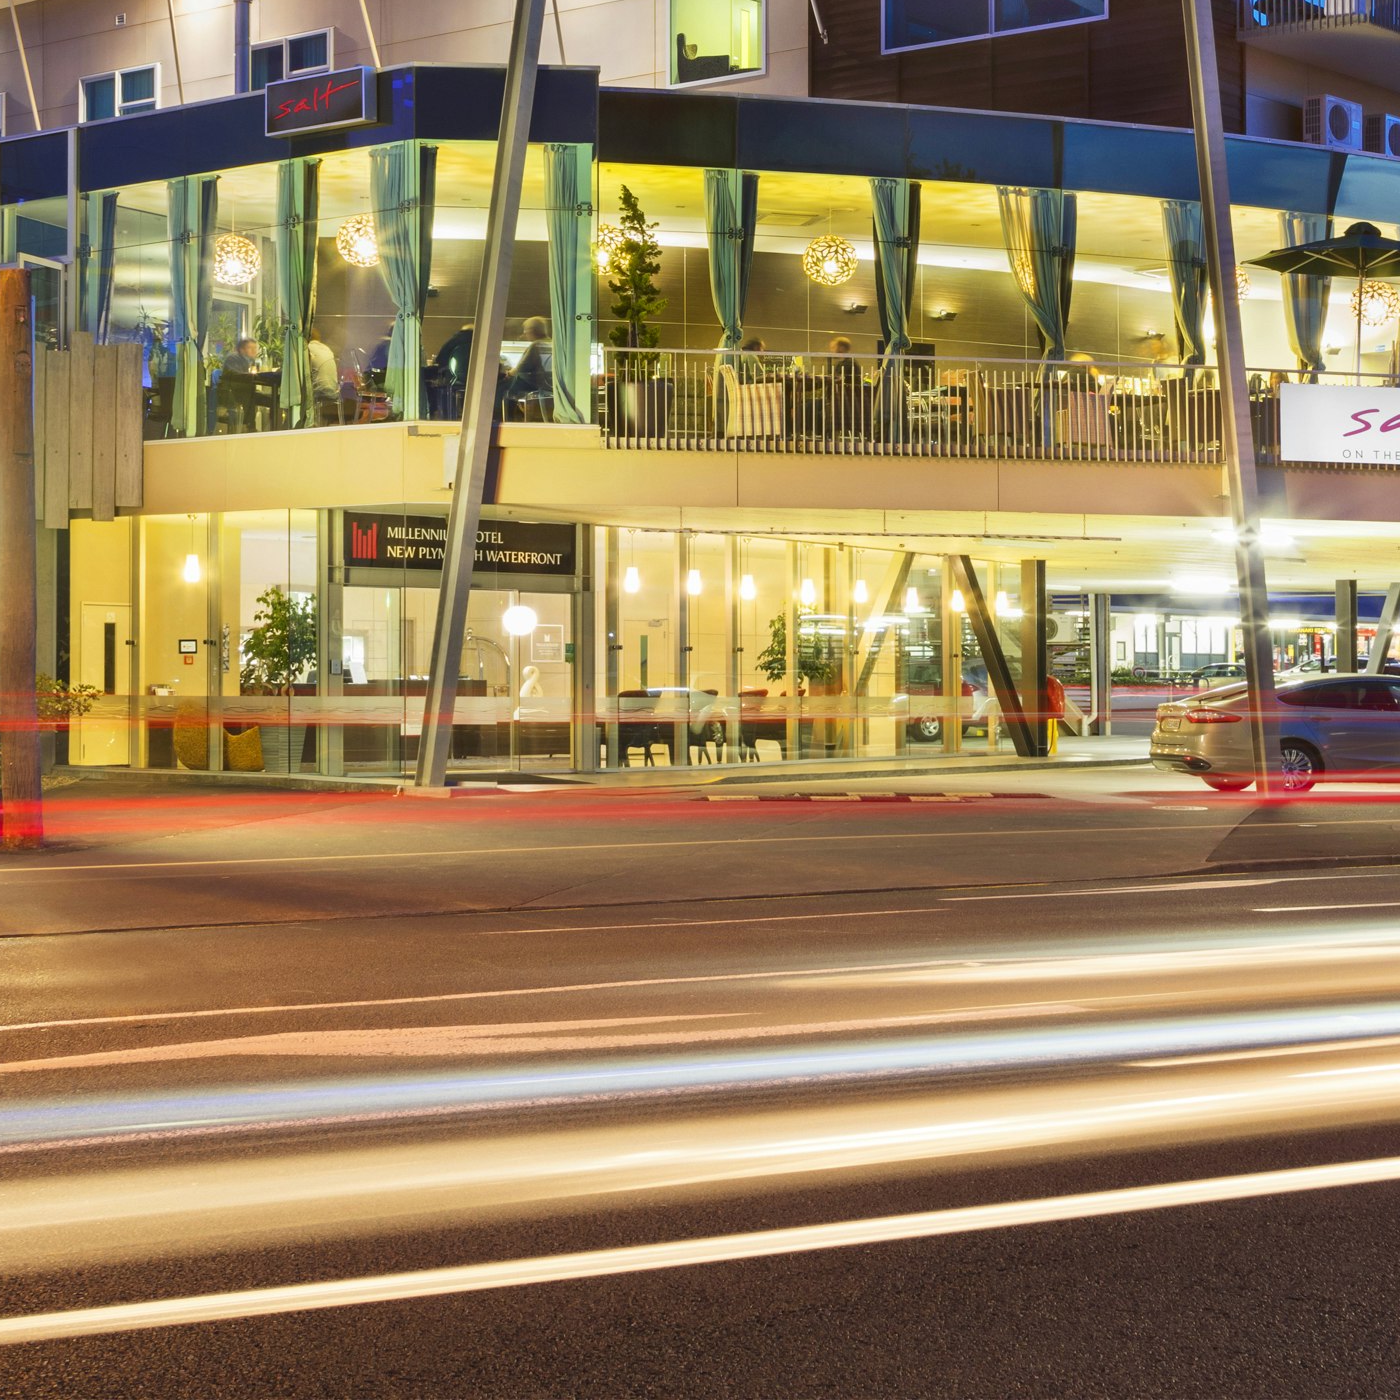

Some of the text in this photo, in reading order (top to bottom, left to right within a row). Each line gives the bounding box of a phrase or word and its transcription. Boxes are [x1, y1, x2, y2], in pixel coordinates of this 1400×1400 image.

[273, 79, 360, 120] salt
[1342, 449, 1364, 459] ON
[1373, 450, 1400, 461] THE
[387, 526, 504, 544] MILLENNIU OTEL
[386, 545, 416, 559] NEW
[486, 550, 563, 566] WATERFRONT
